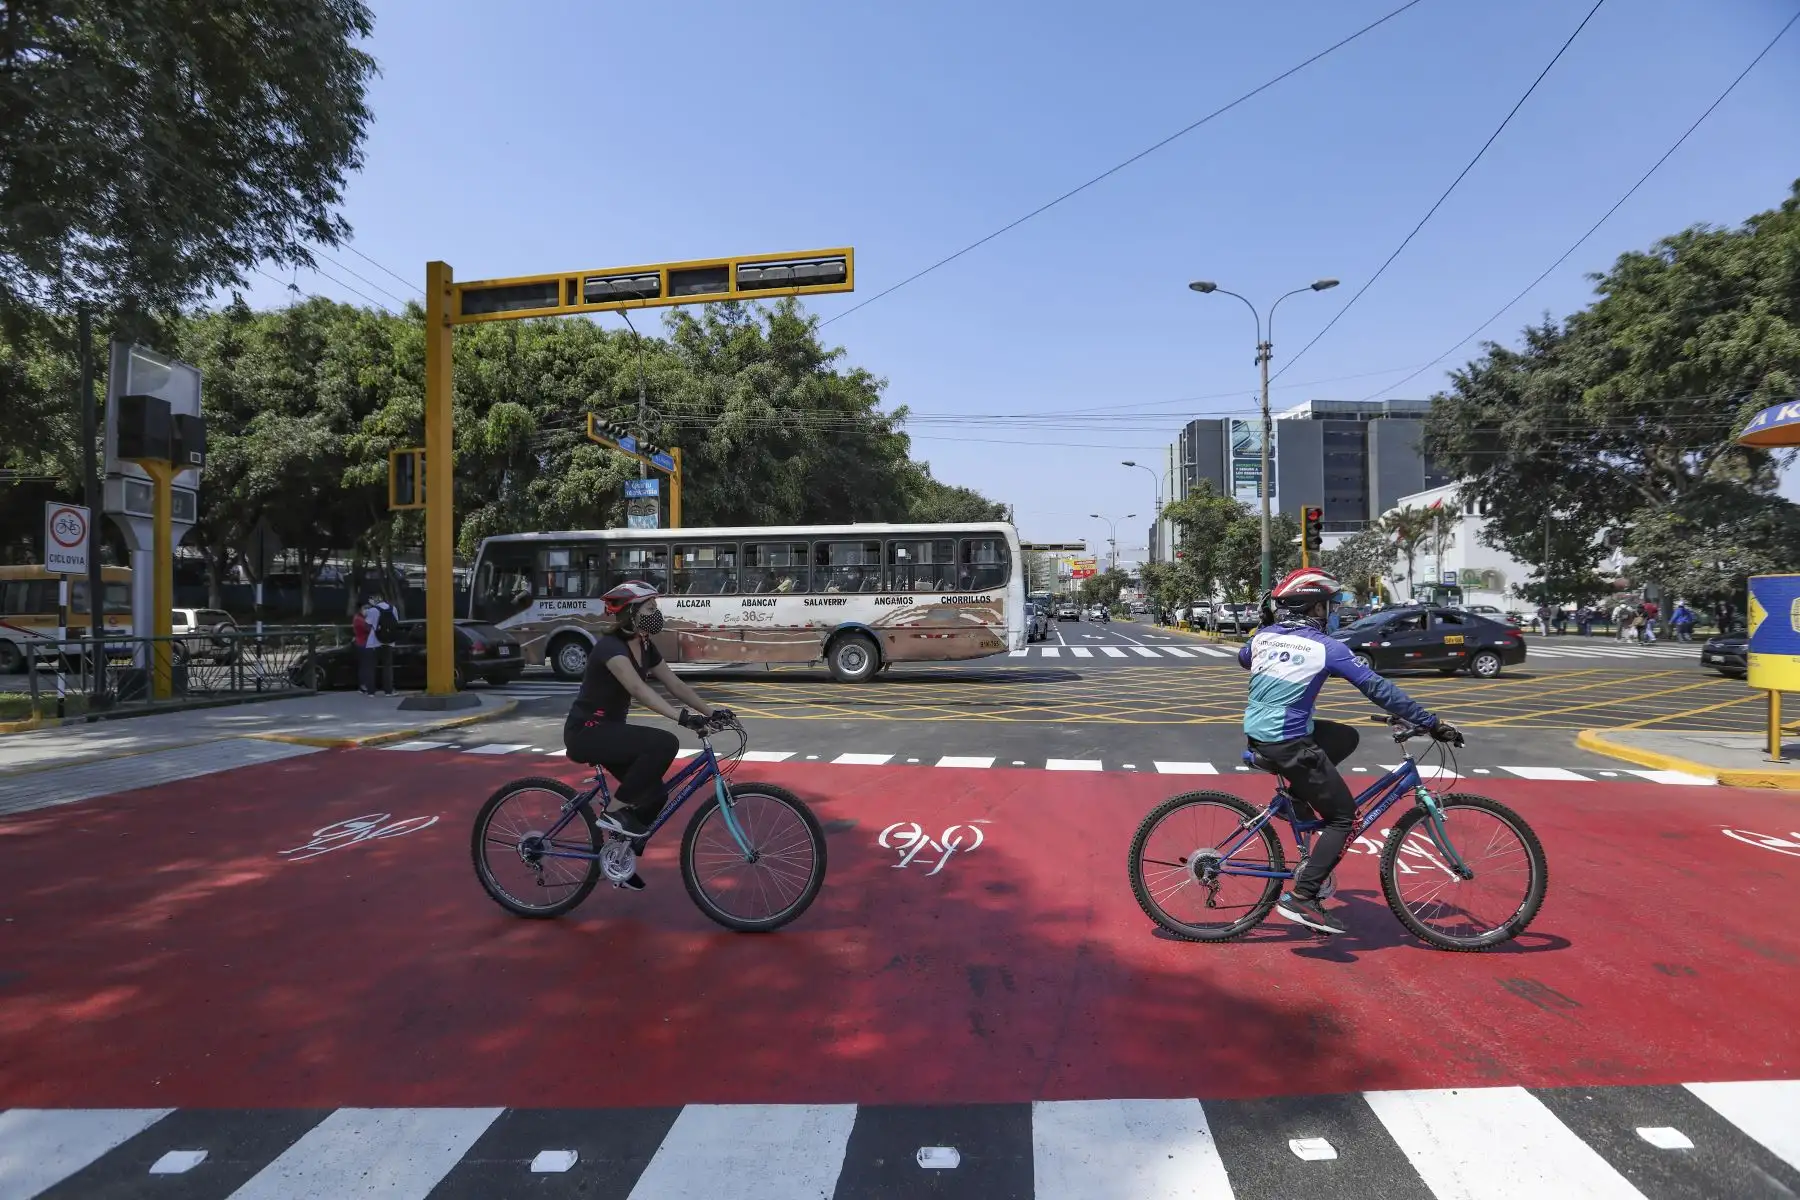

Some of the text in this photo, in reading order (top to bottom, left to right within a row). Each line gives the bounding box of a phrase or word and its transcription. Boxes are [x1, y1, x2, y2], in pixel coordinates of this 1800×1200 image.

[49, 554, 85, 564] CICLOVIA
[741, 598, 777, 607] ABANCAY
[803, 598, 847, 606] SALAVERRY
[874, 597, 914, 605] ANGAMOS
[941, 595, 991, 604] CHORRILLOS
[539, 601, 587, 609] PTE. CAMOTE
